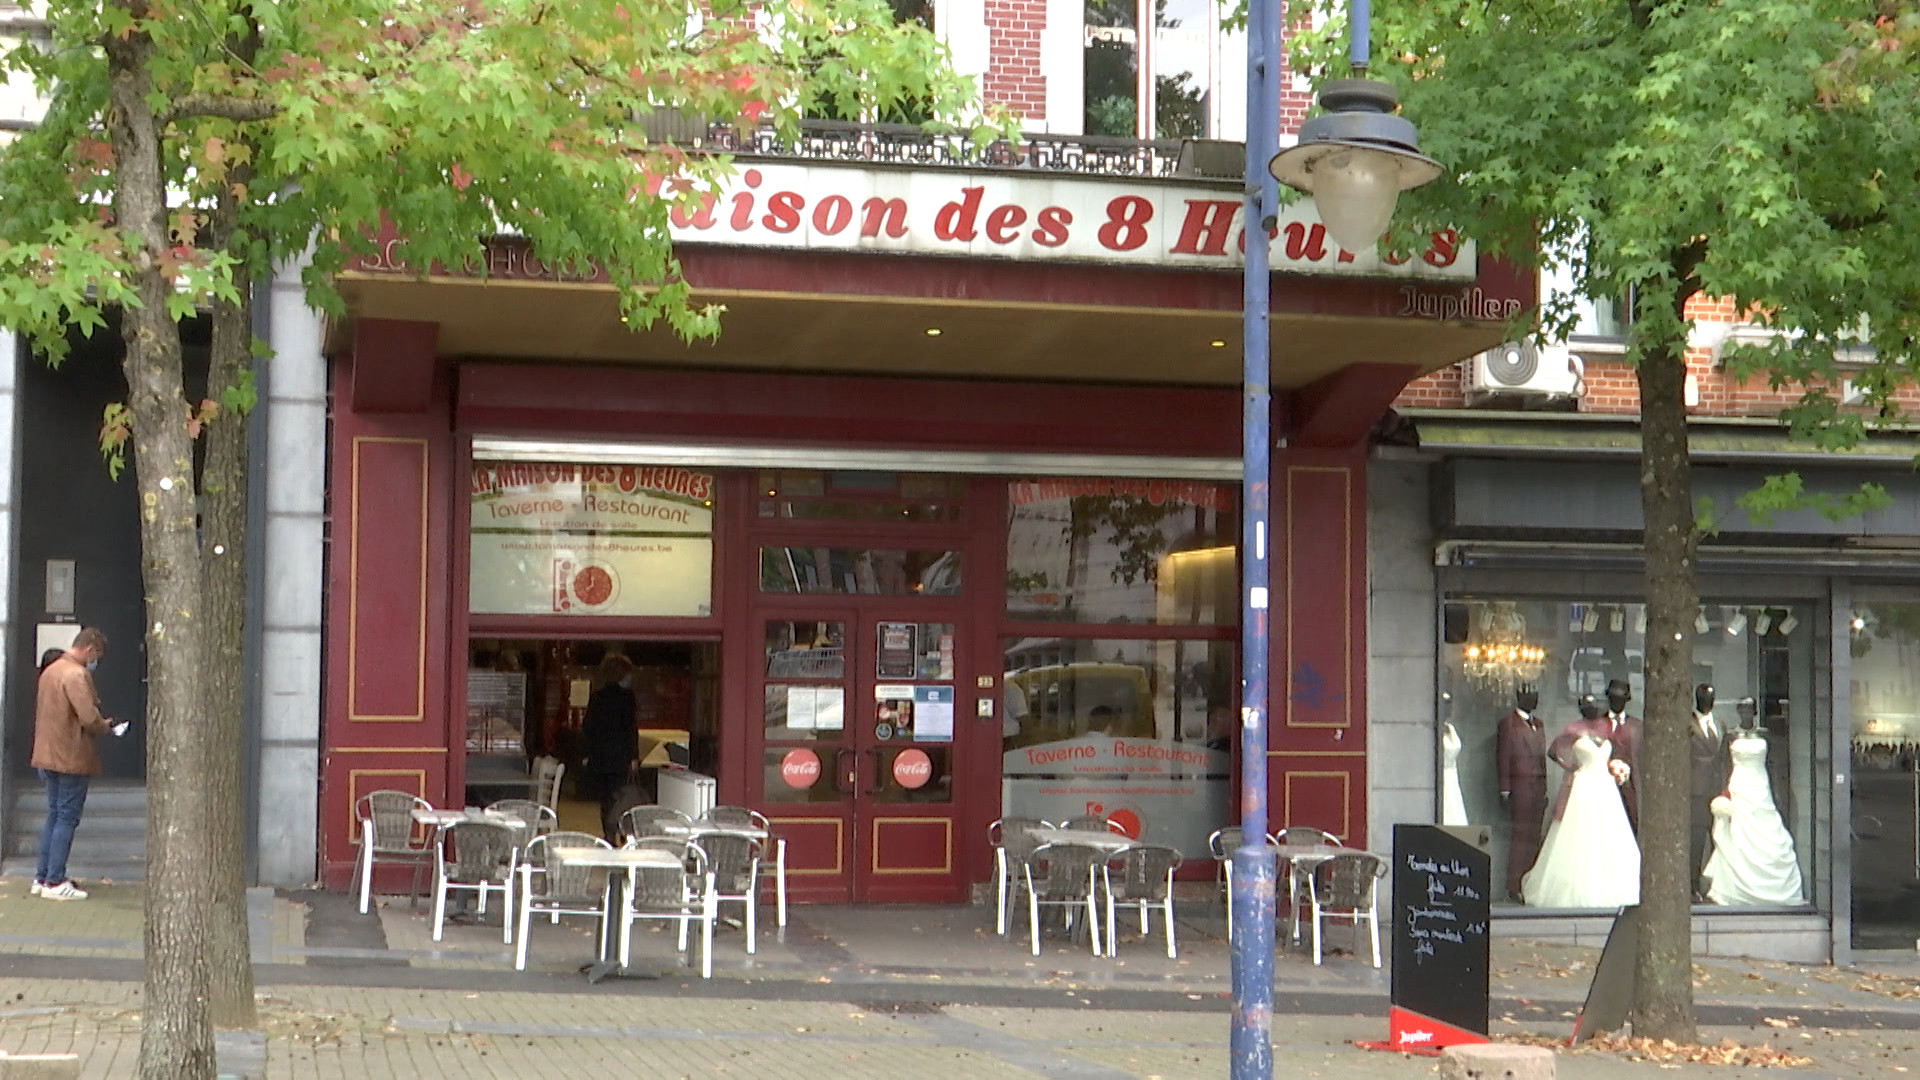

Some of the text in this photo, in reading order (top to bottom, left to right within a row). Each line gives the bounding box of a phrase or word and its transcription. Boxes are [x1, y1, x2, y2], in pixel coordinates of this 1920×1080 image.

[650, 168, 909, 238] aison
[934, 186, 1074, 248] des
[1097, 194, 1155, 252] 8
[495, 463, 576, 488] MAISON
[581, 464, 616, 485] DES
[639, 466, 713, 500] HEURES
[487, 498, 565, 520] Taverne
[584, 495, 691, 525] Restaurant
[1024, 744, 1097, 766] Taverne
[1113, 740, 1212, 768] Restaurant
